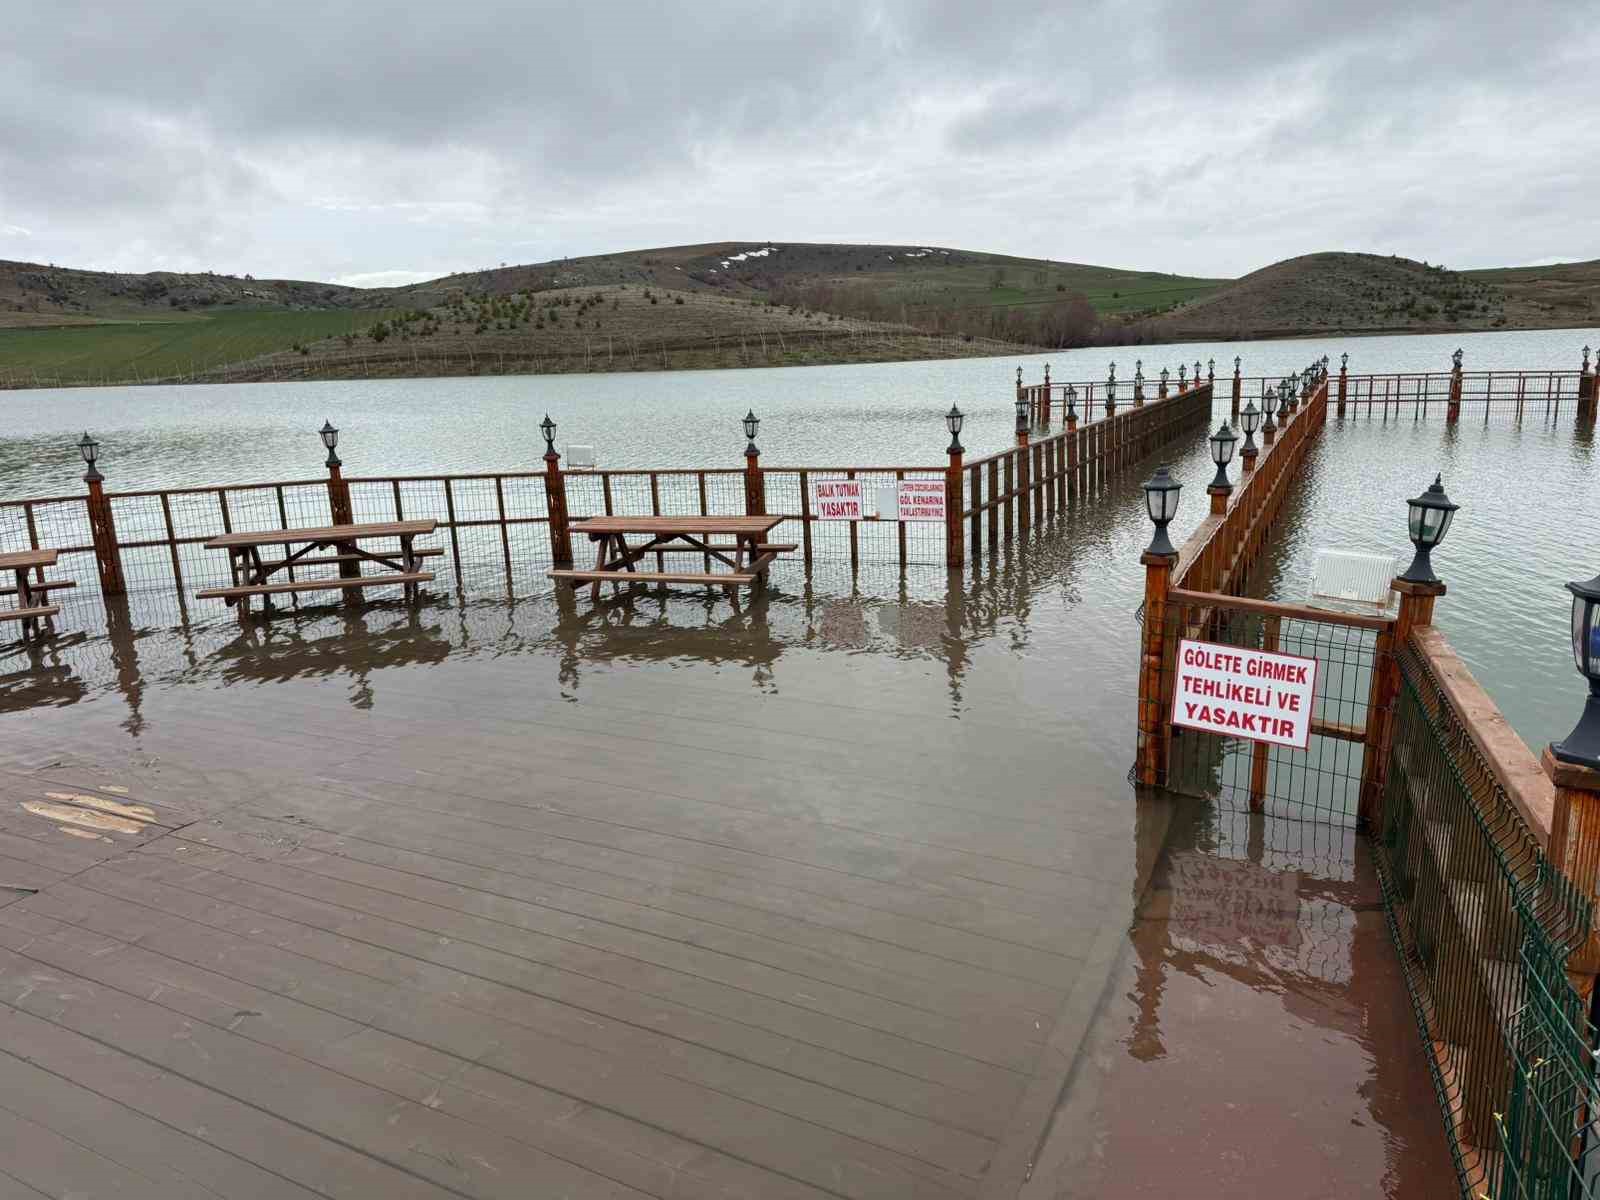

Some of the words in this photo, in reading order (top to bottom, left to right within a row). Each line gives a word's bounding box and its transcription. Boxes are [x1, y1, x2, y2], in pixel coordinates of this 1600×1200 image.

[817, 484, 834, 498] BALIK
[836, 483, 860, 497] TUTMAK
[821, 501, 859, 517] YASAKTIR
[1246, 656, 1307, 684] GİRMEK
[1182, 675, 1271, 707] TEHLİKELİ
[1277, 691, 1301, 712] VE
[1185, 702, 1295, 738] YASAKTIR
